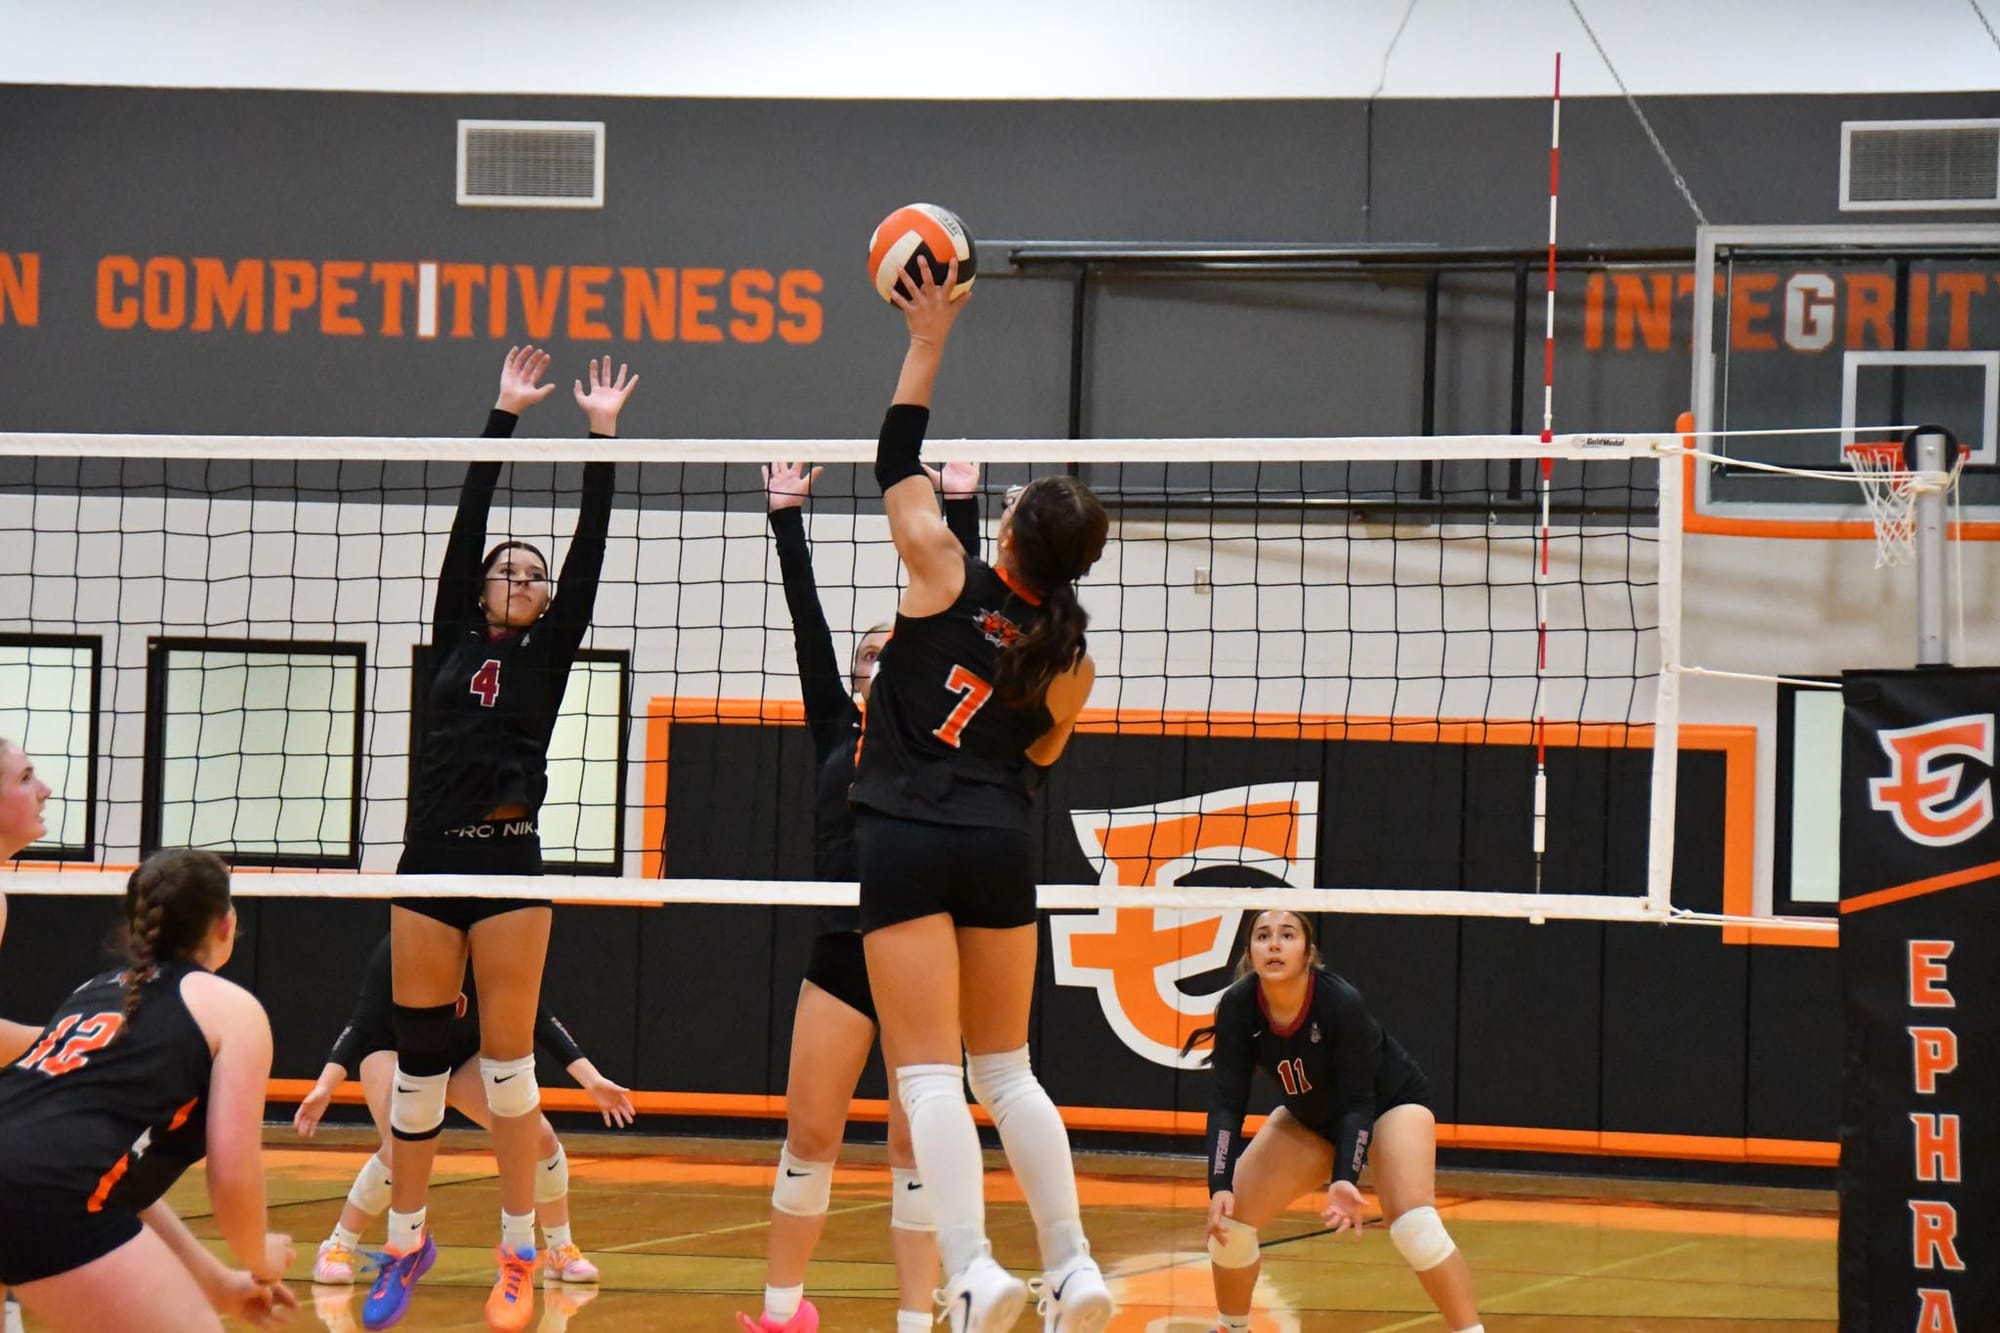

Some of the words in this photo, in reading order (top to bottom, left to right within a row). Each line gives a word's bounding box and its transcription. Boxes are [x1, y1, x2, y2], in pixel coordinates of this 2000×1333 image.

[97, 255, 824, 343] COMPETITIVENESS
[1584, 272, 2000, 353] INEGRIT
[470, 659, 501, 707] 4
[932, 664, 993, 748] 7
[503, 821, 538, 837] NIK
[15, 1011, 124, 1077] 12
[1277, 1057, 1312, 1095] 11
